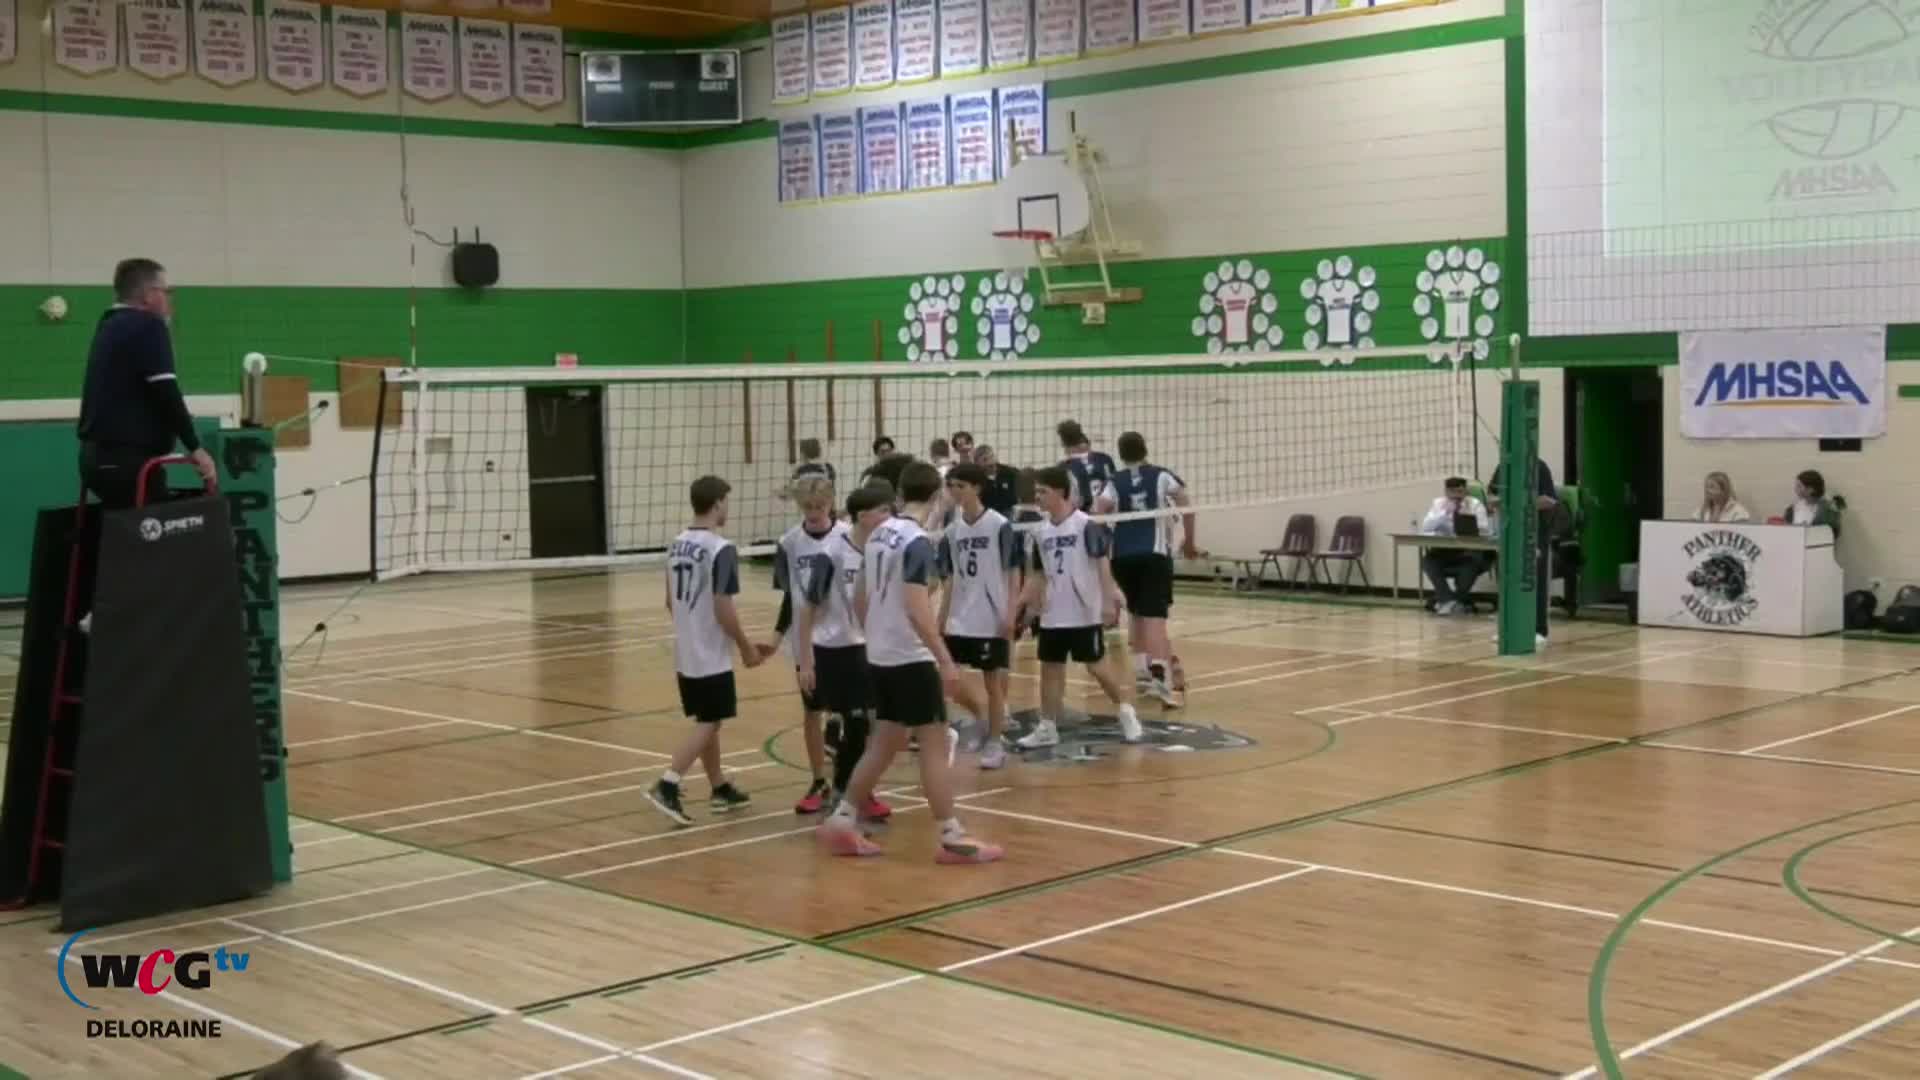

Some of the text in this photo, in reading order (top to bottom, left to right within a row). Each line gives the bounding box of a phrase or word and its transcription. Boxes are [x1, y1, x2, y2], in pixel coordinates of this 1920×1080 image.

[1694, 360, 1871, 408] MHSAA
[1683, 529, 1764, 562] PANTHER
[966, 551, 978, 577] 6
[1681, 593, 1760, 625] ATHLETICS
